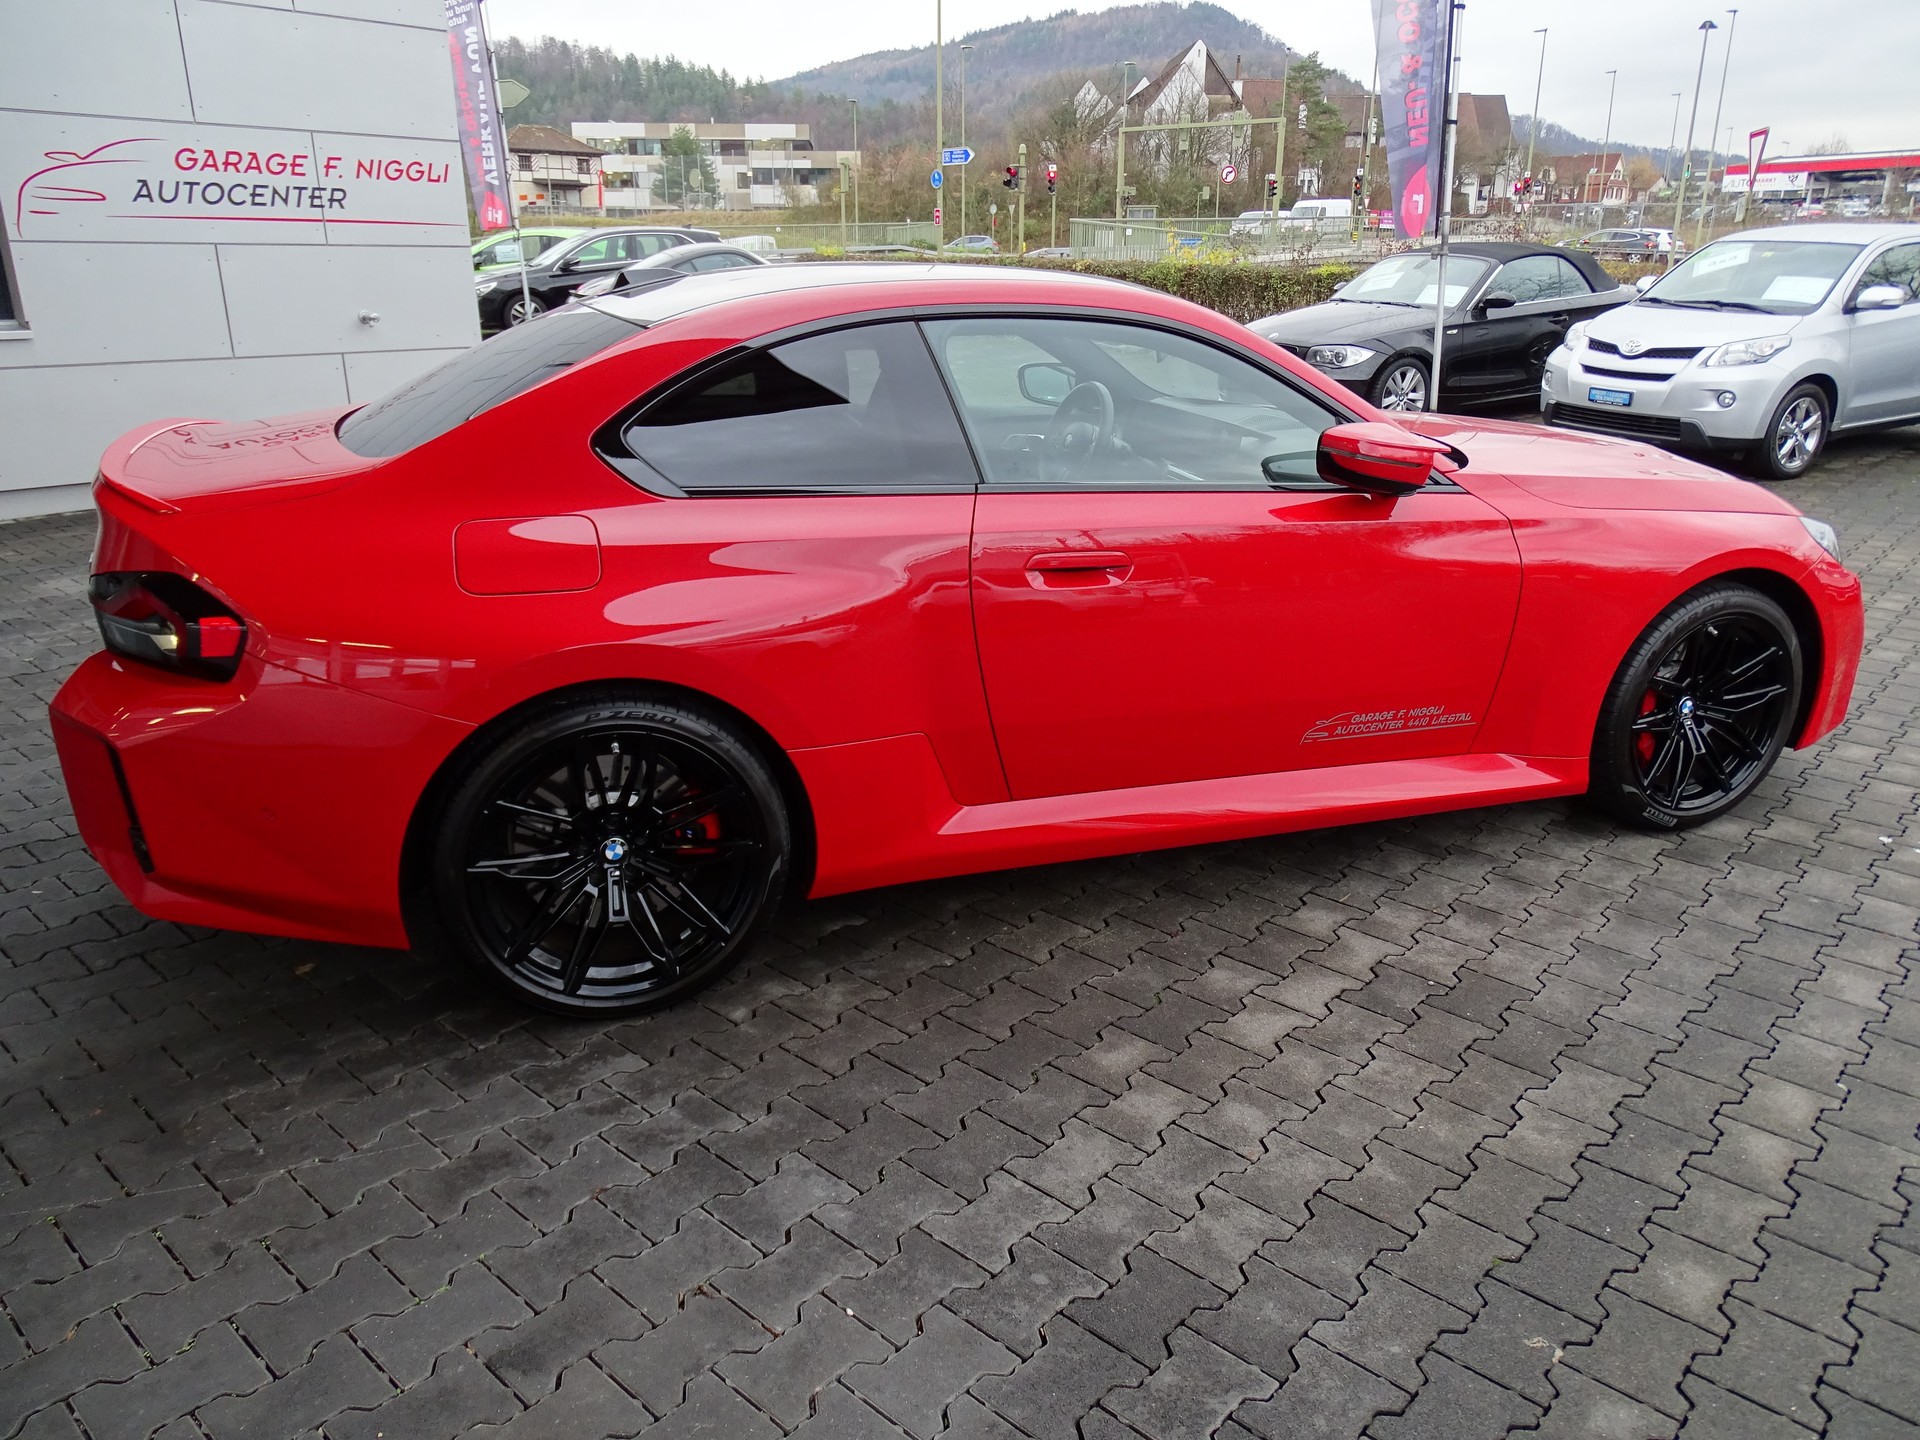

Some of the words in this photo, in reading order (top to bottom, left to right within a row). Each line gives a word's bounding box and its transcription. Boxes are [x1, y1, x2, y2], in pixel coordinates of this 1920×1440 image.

[174, 147, 309, 177] GARAGE
[323, 156, 345, 180] F.
[355, 158, 451, 184] NIGGLI
[132, 179, 348, 210] AUTOCENTER
[606, 710, 678, 724] ZERO
[1334, 720, 1404, 735] AUTOCENTER
[1407, 718, 1429, 727] 4410
[1431, 712, 1472, 724] LIESTAL
[1351, 711, 1396, 723] GARAGE
[1397, 709, 1407, 718] F.
[1408, 706, 1445, 717] NIGGLI
